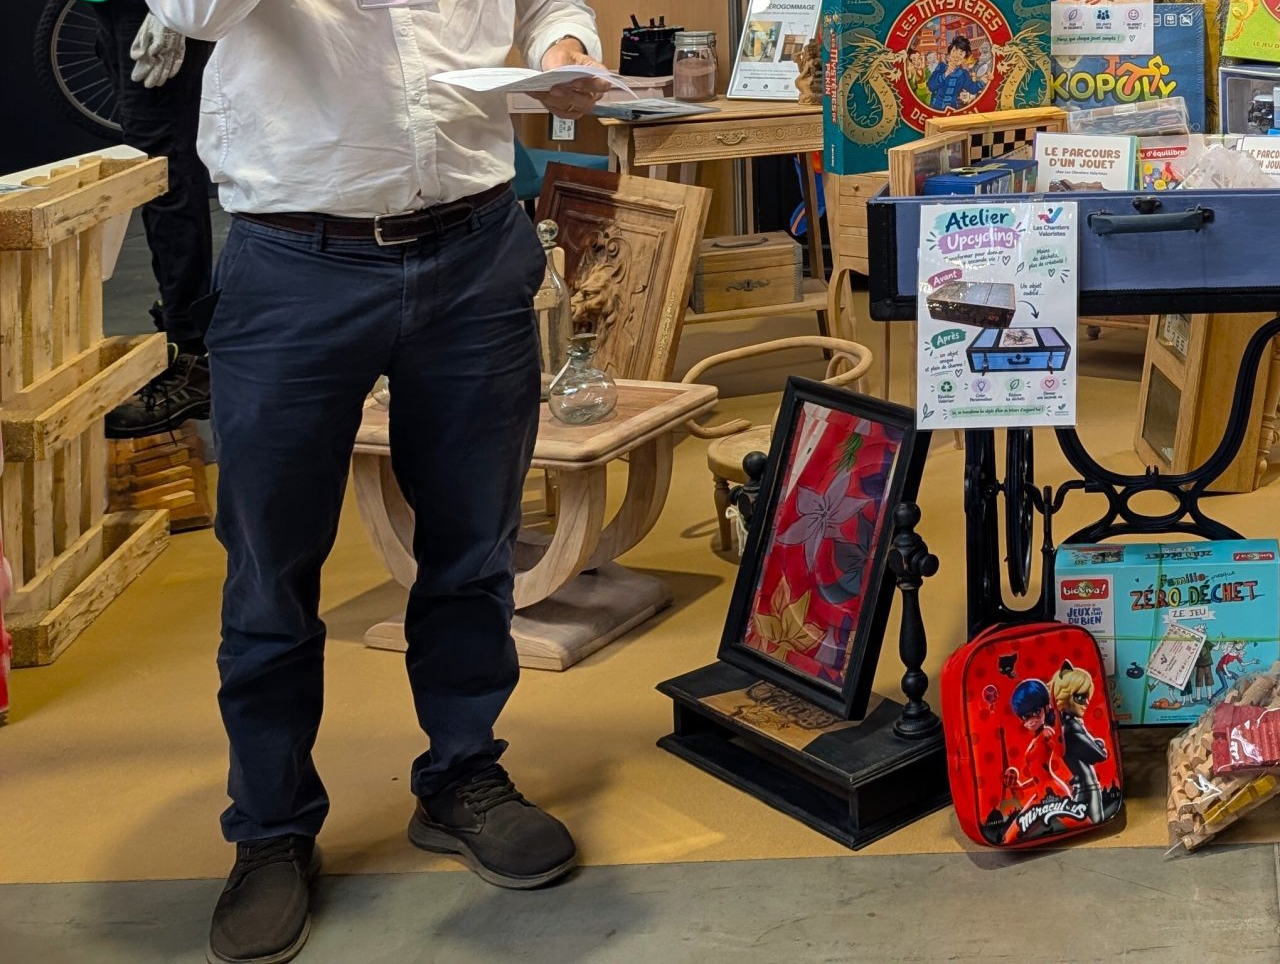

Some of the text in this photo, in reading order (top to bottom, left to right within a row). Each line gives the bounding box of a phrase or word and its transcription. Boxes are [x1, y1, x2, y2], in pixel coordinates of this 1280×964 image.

[896, 14, 918, 38] LES
[1261, 41, 1273, 49] JEU
[1044, 146, 1121, 159] LE PARCOURS
[1049, 157, 1116, 170] D'UN JOUET
[944, 208, 1010, 233] Atelier
[946, 229, 1015, 251] Upcycling
[933, 270, 958, 285] Avant
[936, 332, 960, 346] Après
[1160, 572, 1207, 587] Famille
[1129, 579, 1259, 611] ZÉRO DÉCHET
[1067, 607, 1091, 618] JEUX
[1171, 608, 1207, 618] ZE JEU
[1068, 616, 1102, 626] DU BIEN
